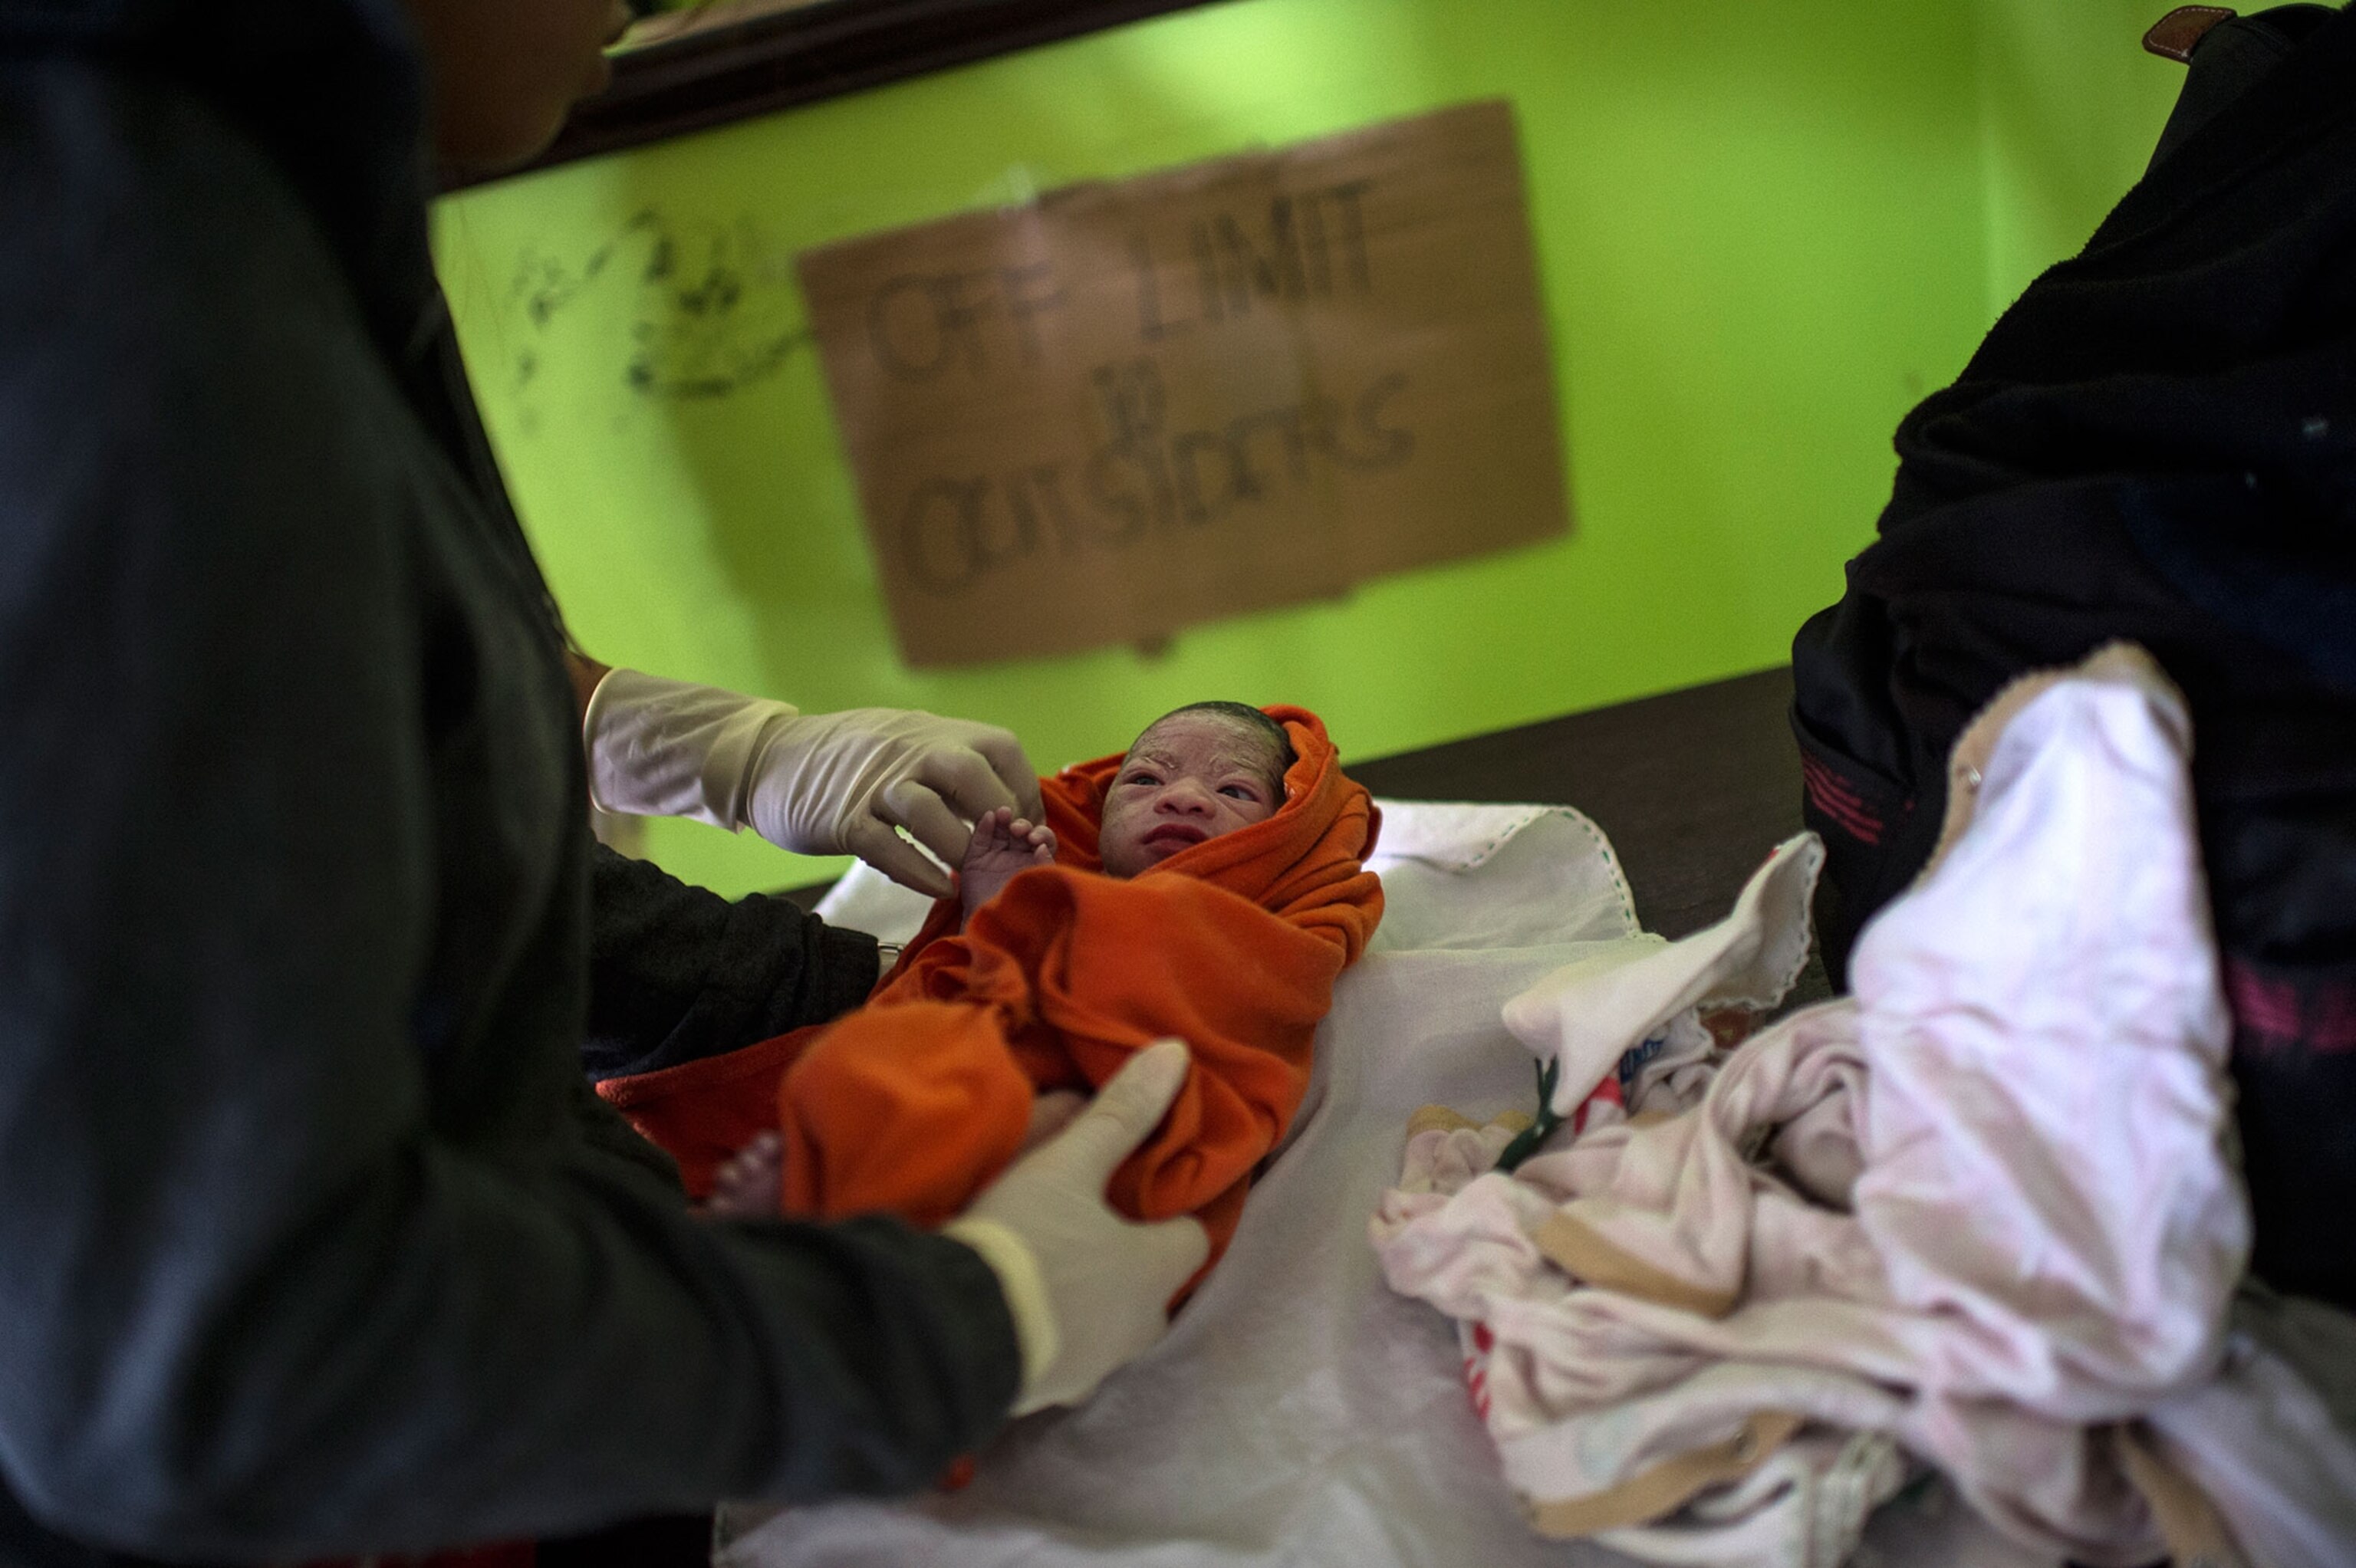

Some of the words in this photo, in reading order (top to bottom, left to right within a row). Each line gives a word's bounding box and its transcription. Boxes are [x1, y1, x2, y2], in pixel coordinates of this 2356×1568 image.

[866, 259, 1069, 385] OFF
[1127, 176, 1377, 343] LIMIT
[897, 370, 1419, 600] OUTSIDERS
[1091, 355, 1168, 453] TO
